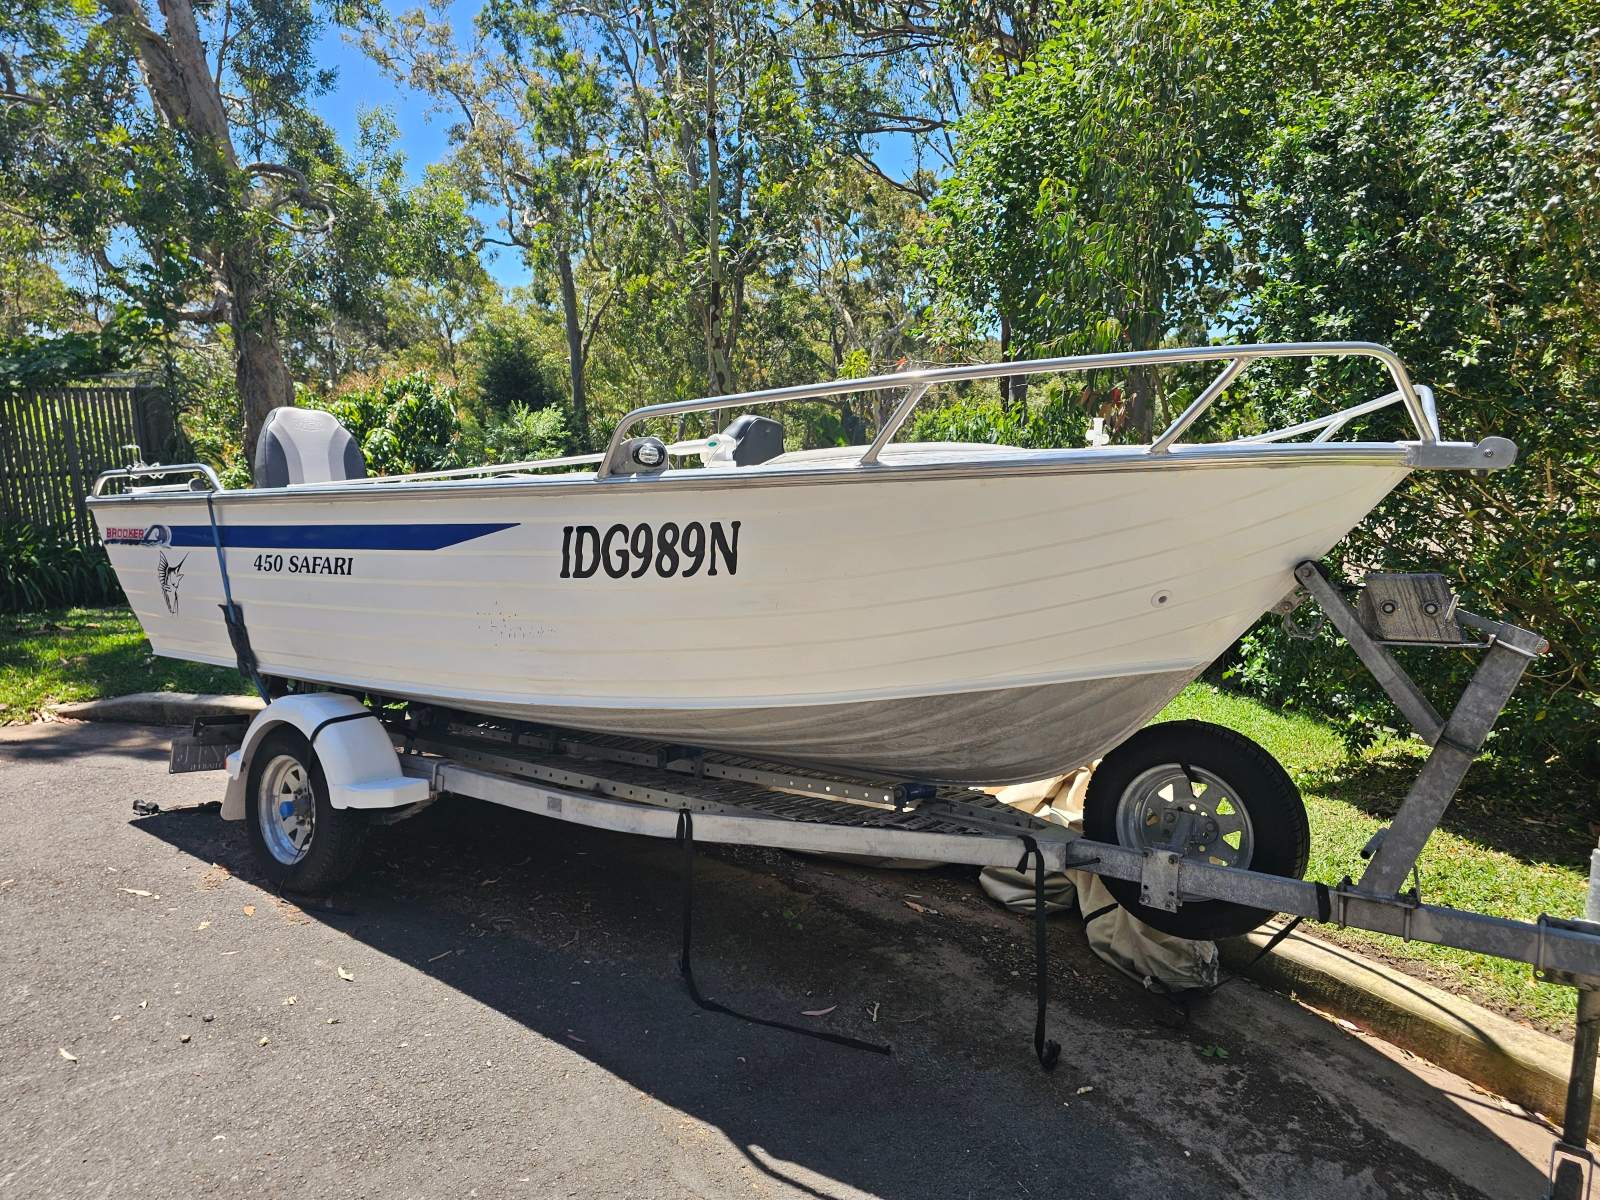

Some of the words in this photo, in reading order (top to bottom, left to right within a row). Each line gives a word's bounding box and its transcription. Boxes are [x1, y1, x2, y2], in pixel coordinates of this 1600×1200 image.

[106, 527, 144, 538] BROOKER
[560, 521, 741, 579] IDG989N
[253, 554, 283, 572] 450
[288, 555, 354, 575] SAFARI
